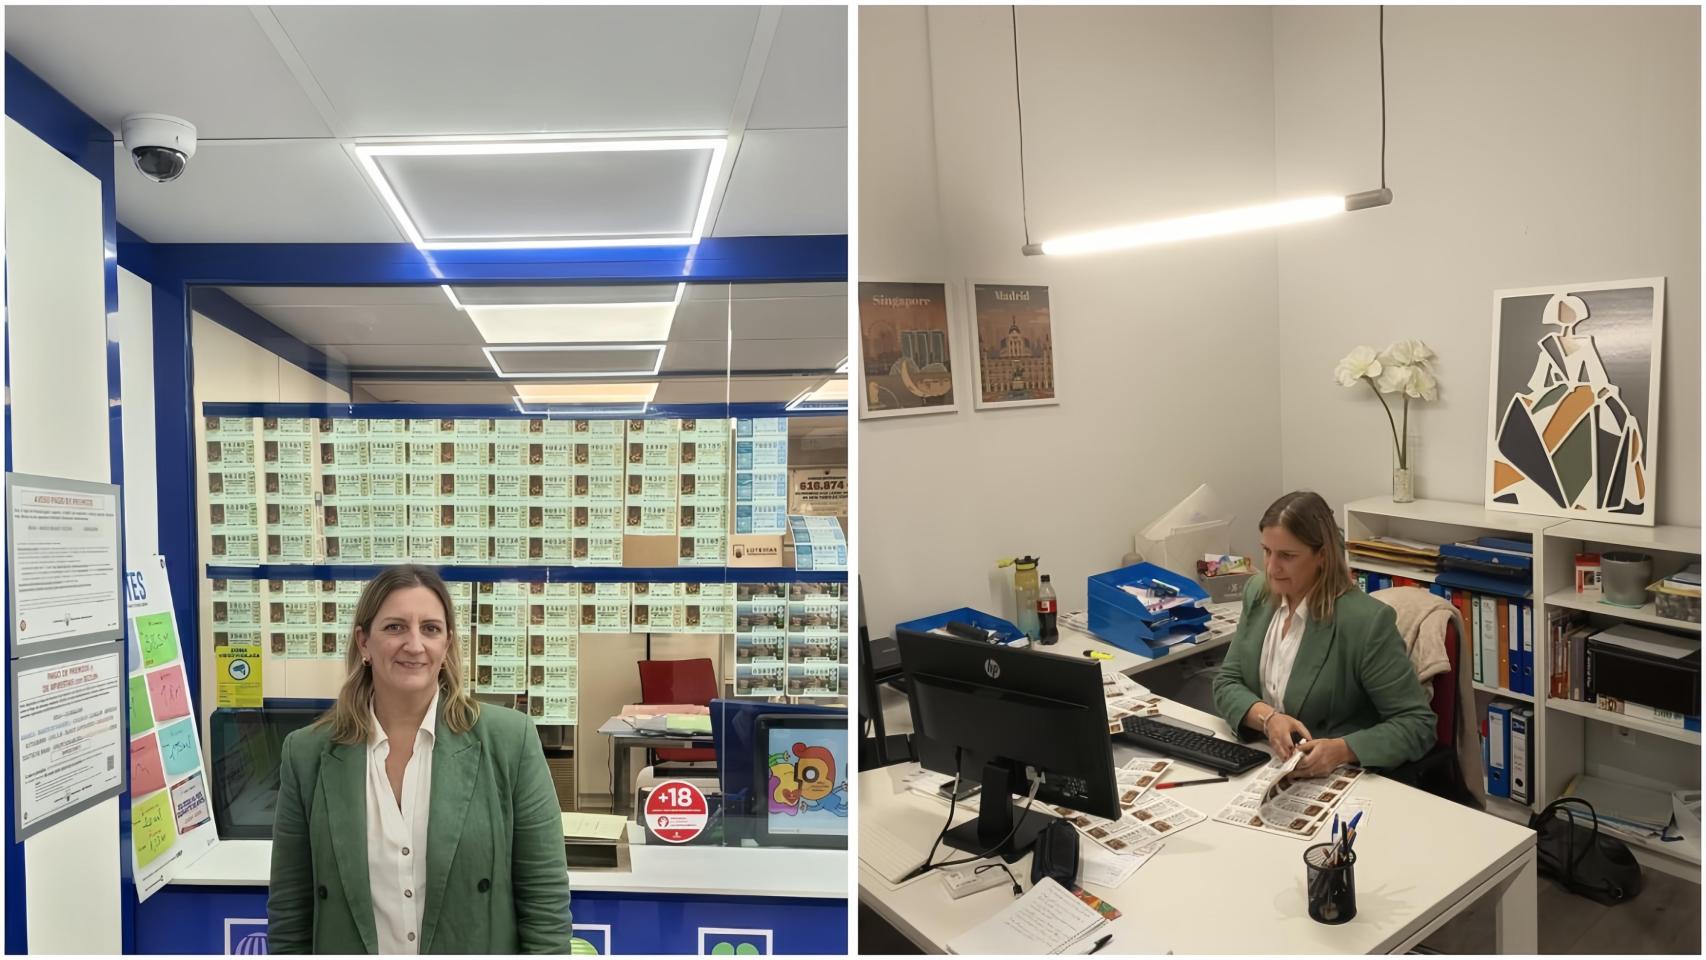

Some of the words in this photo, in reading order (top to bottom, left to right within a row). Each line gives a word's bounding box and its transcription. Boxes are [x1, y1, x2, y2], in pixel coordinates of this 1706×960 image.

[872, 294, 931, 308] Singapore
[994, 289, 1030, 302] Madrid
[658, 787, 693, 807] +18
